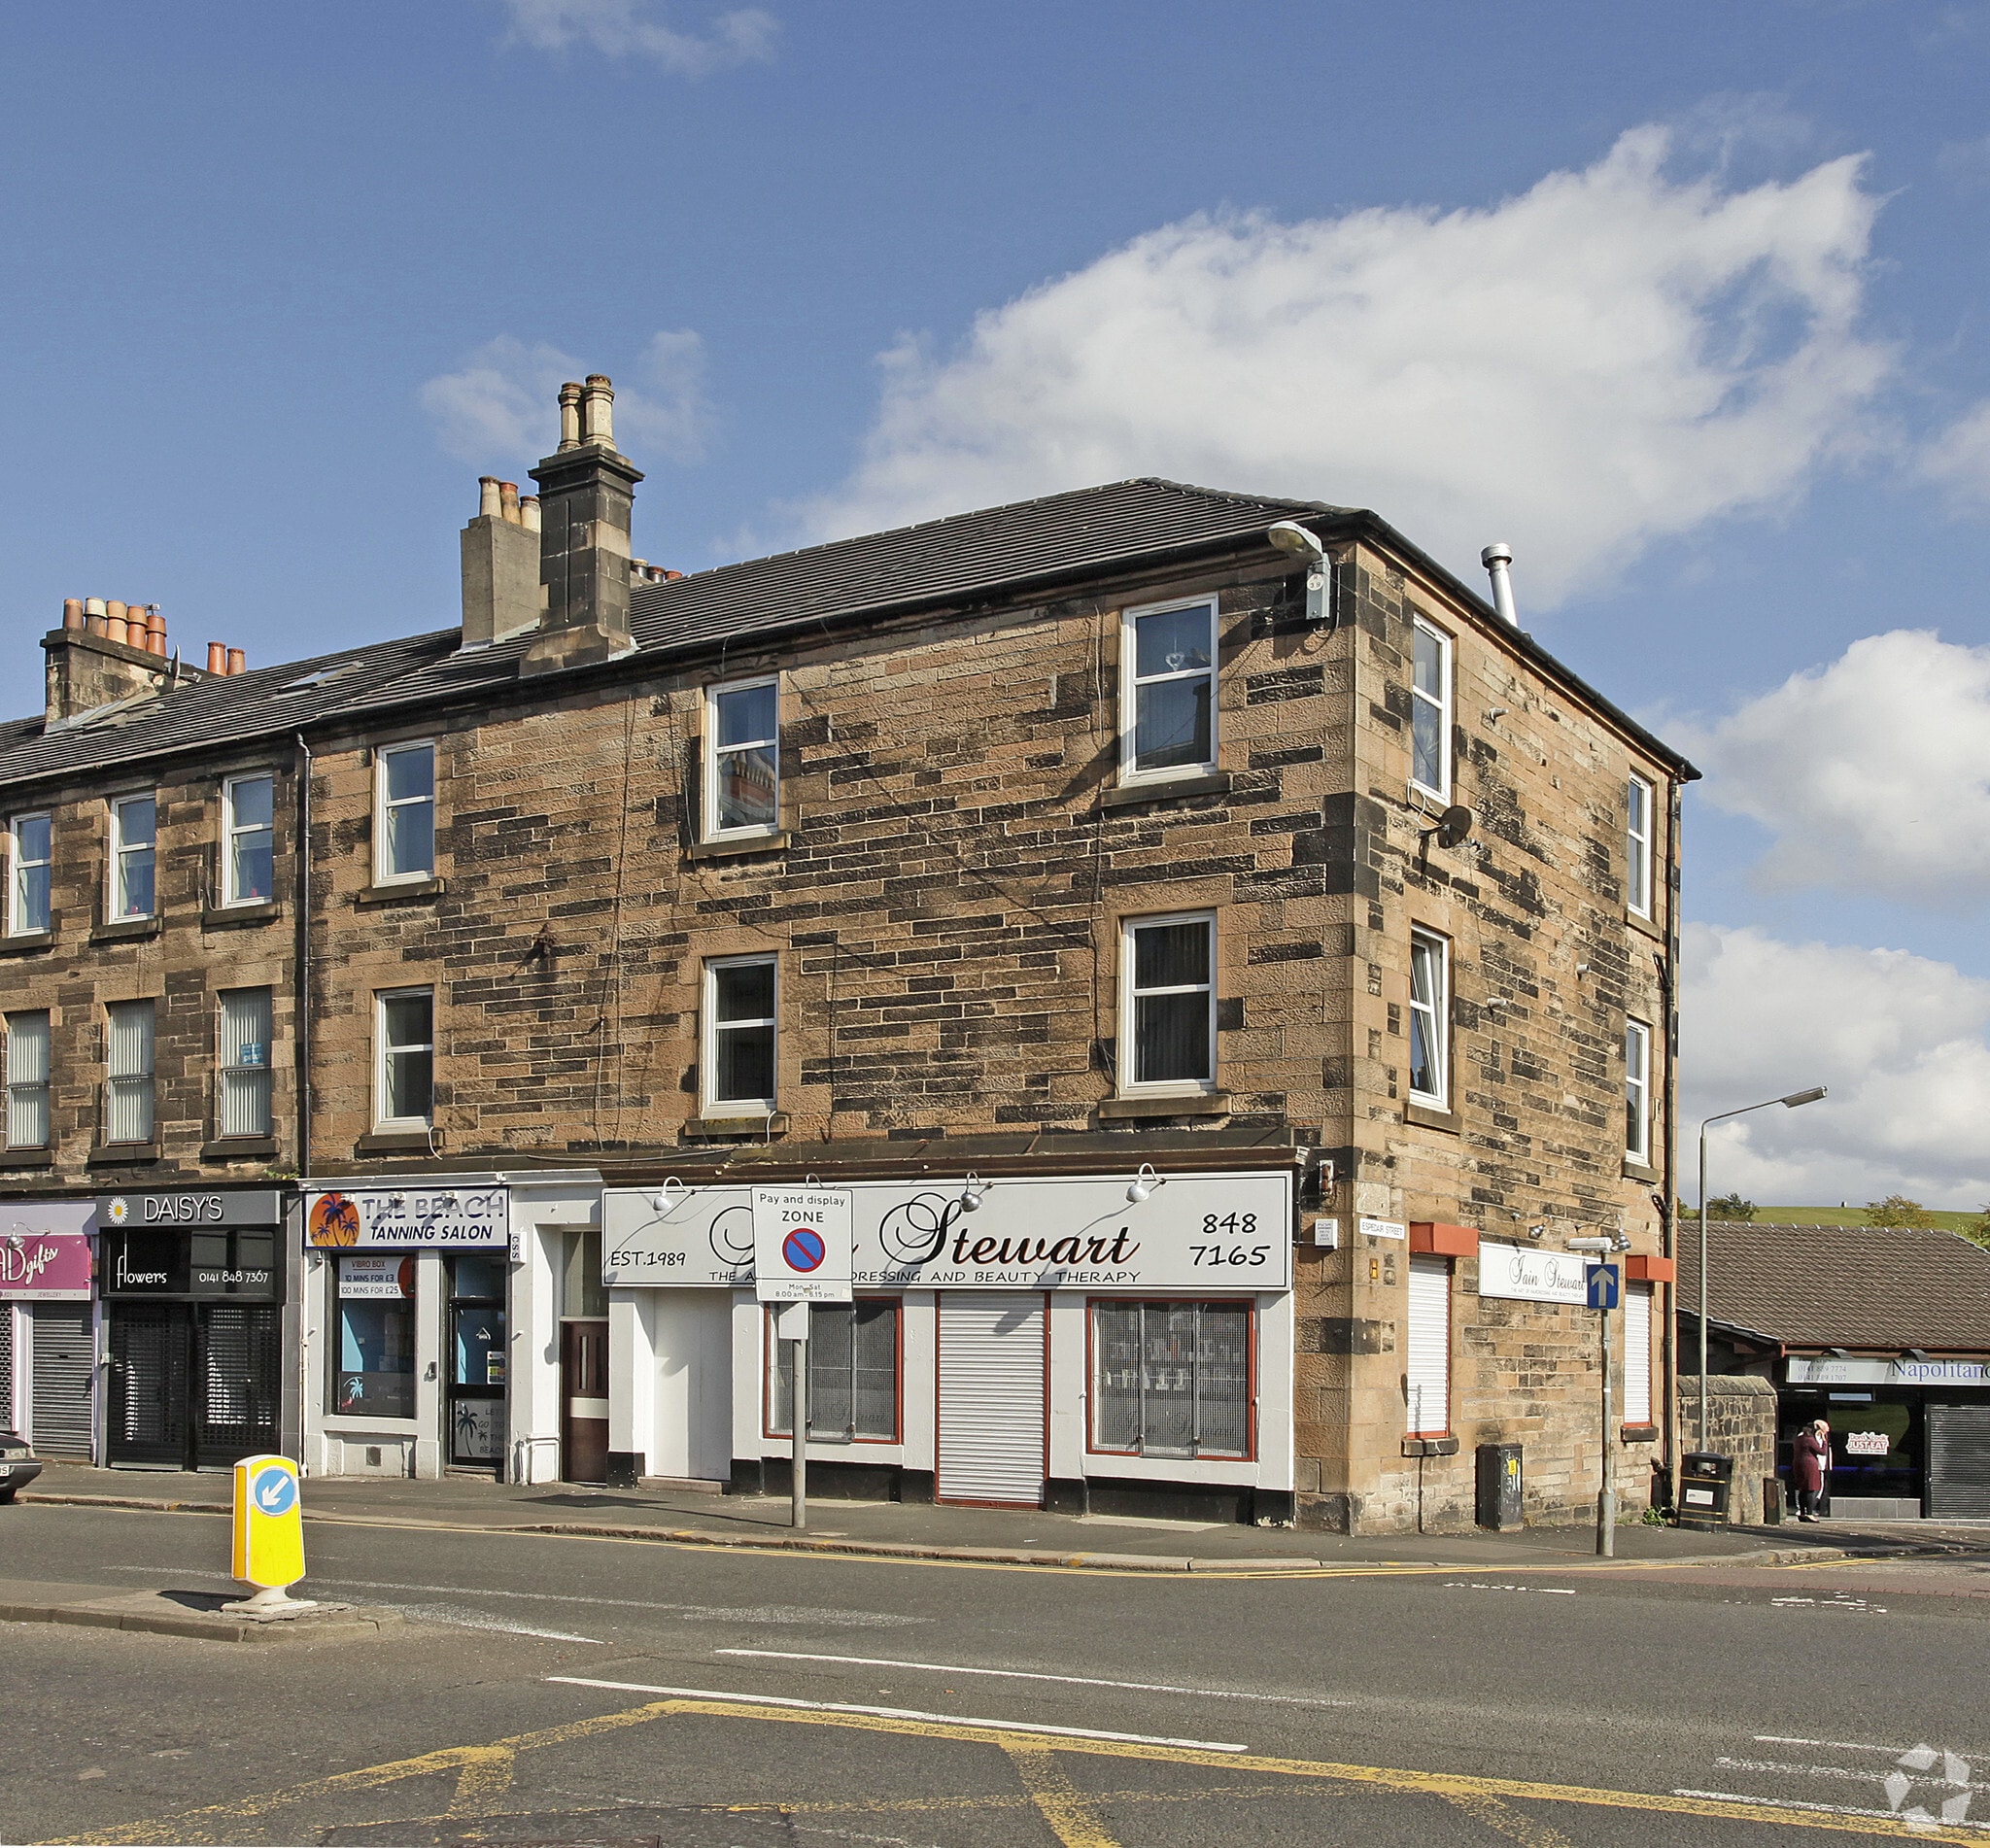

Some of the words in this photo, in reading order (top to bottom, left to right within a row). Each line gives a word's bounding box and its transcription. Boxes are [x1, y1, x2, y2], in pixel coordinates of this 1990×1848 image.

[145, 1196, 223, 1220] DAISY'S
[361, 1198, 406, 1219] THE
[415, 1196, 503, 1219] BEACH
[760, 1193, 779, 1205] Pay
[783, 1195, 804, 1204] and
[807, 1195, 845, 1207] display
[781, 1211, 824, 1222] ZONE
[1202, 1212, 1257, 1234] 848
[370, 1225, 435, 1240] TANNING
[440, 1225, 493, 1240] SALON
[879, 1192, 1141, 1265] Stewart
[1386, 1225, 1403, 1236] STREET
[25, 1244, 58, 1285] gifts
[117, 1232, 167, 1288] flowers
[610, 1251, 686, 1266] EST.1989
[1189, 1246, 1271, 1266] 7165
[199, 1273, 219, 1283] 0141
[222, 1270, 243, 1283] 848
[245, 1270, 269, 1283] 7367
[709, 1272, 737, 1282] THE
[930, 1272, 966, 1283] AND
[975, 1271, 1046, 1283] BEAUTY
[1054, 1271, 1141, 1283] THERAPY
[1509, 1254, 1539, 1286] Iain
[1544, 1257, 1586, 1291] Stewart
[1870, 1441, 1886, 1450] EAT
